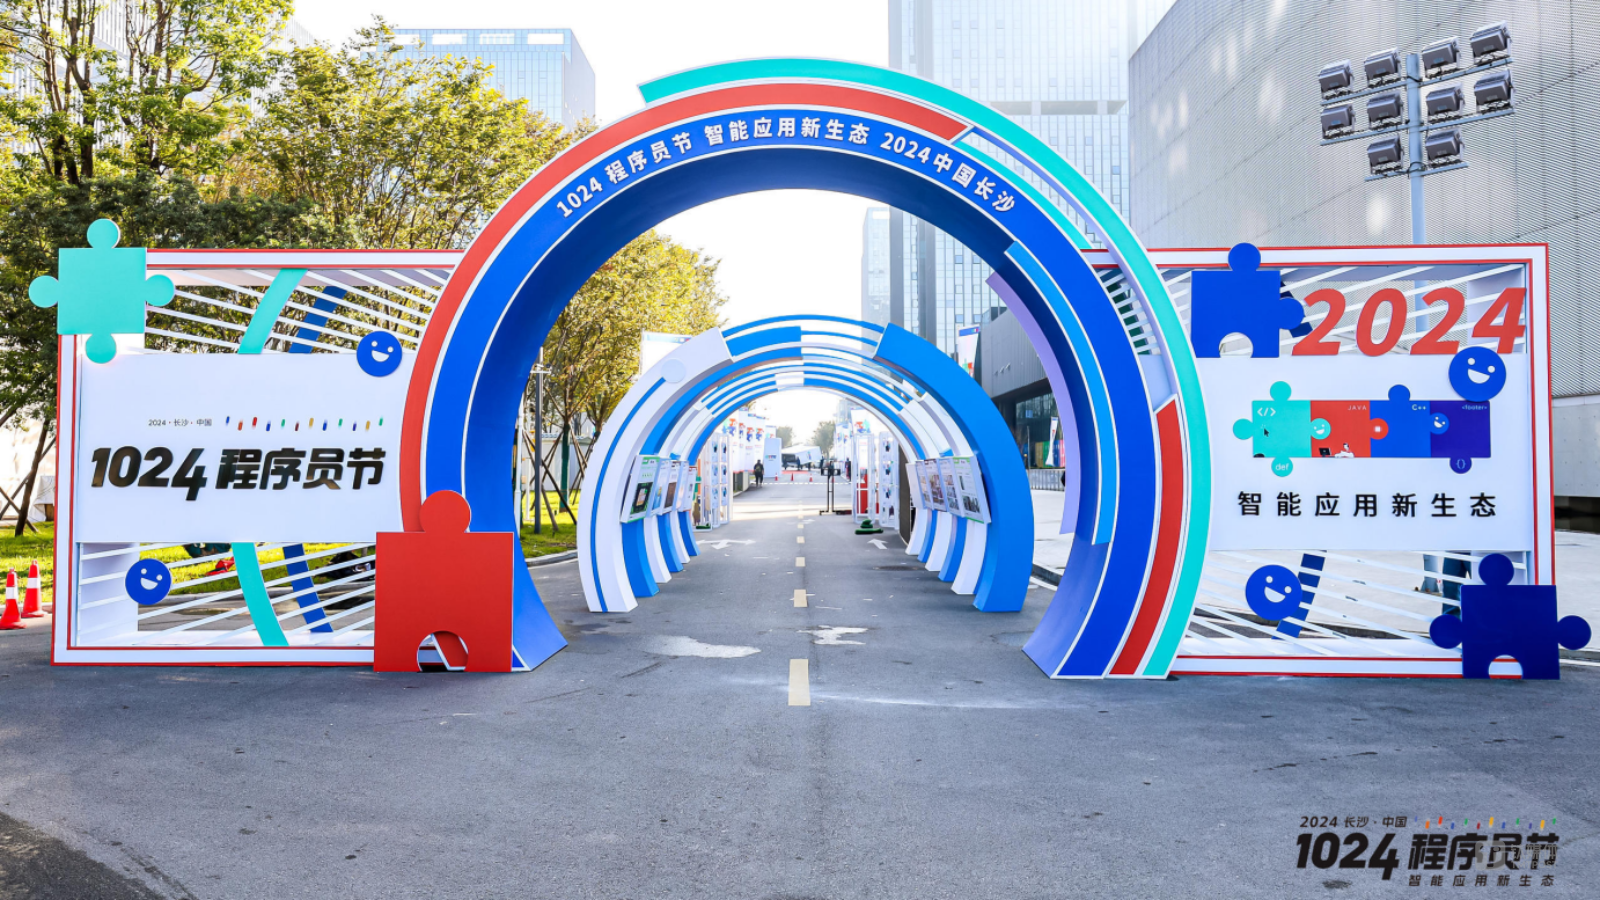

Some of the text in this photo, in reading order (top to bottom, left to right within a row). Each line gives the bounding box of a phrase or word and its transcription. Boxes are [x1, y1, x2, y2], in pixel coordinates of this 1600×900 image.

[556, 177, 603, 218] 1024
[605, 132, 692, 184] 程序员节
[704, 117, 870, 145] 智能应用新生态
[1292, 287, 1527, 357] 2024
[91, 446, 386, 501] 1024 程序员节
[1275, 463, 1289, 471] def
[1237, 491, 1497, 518] 智能应用新生态
